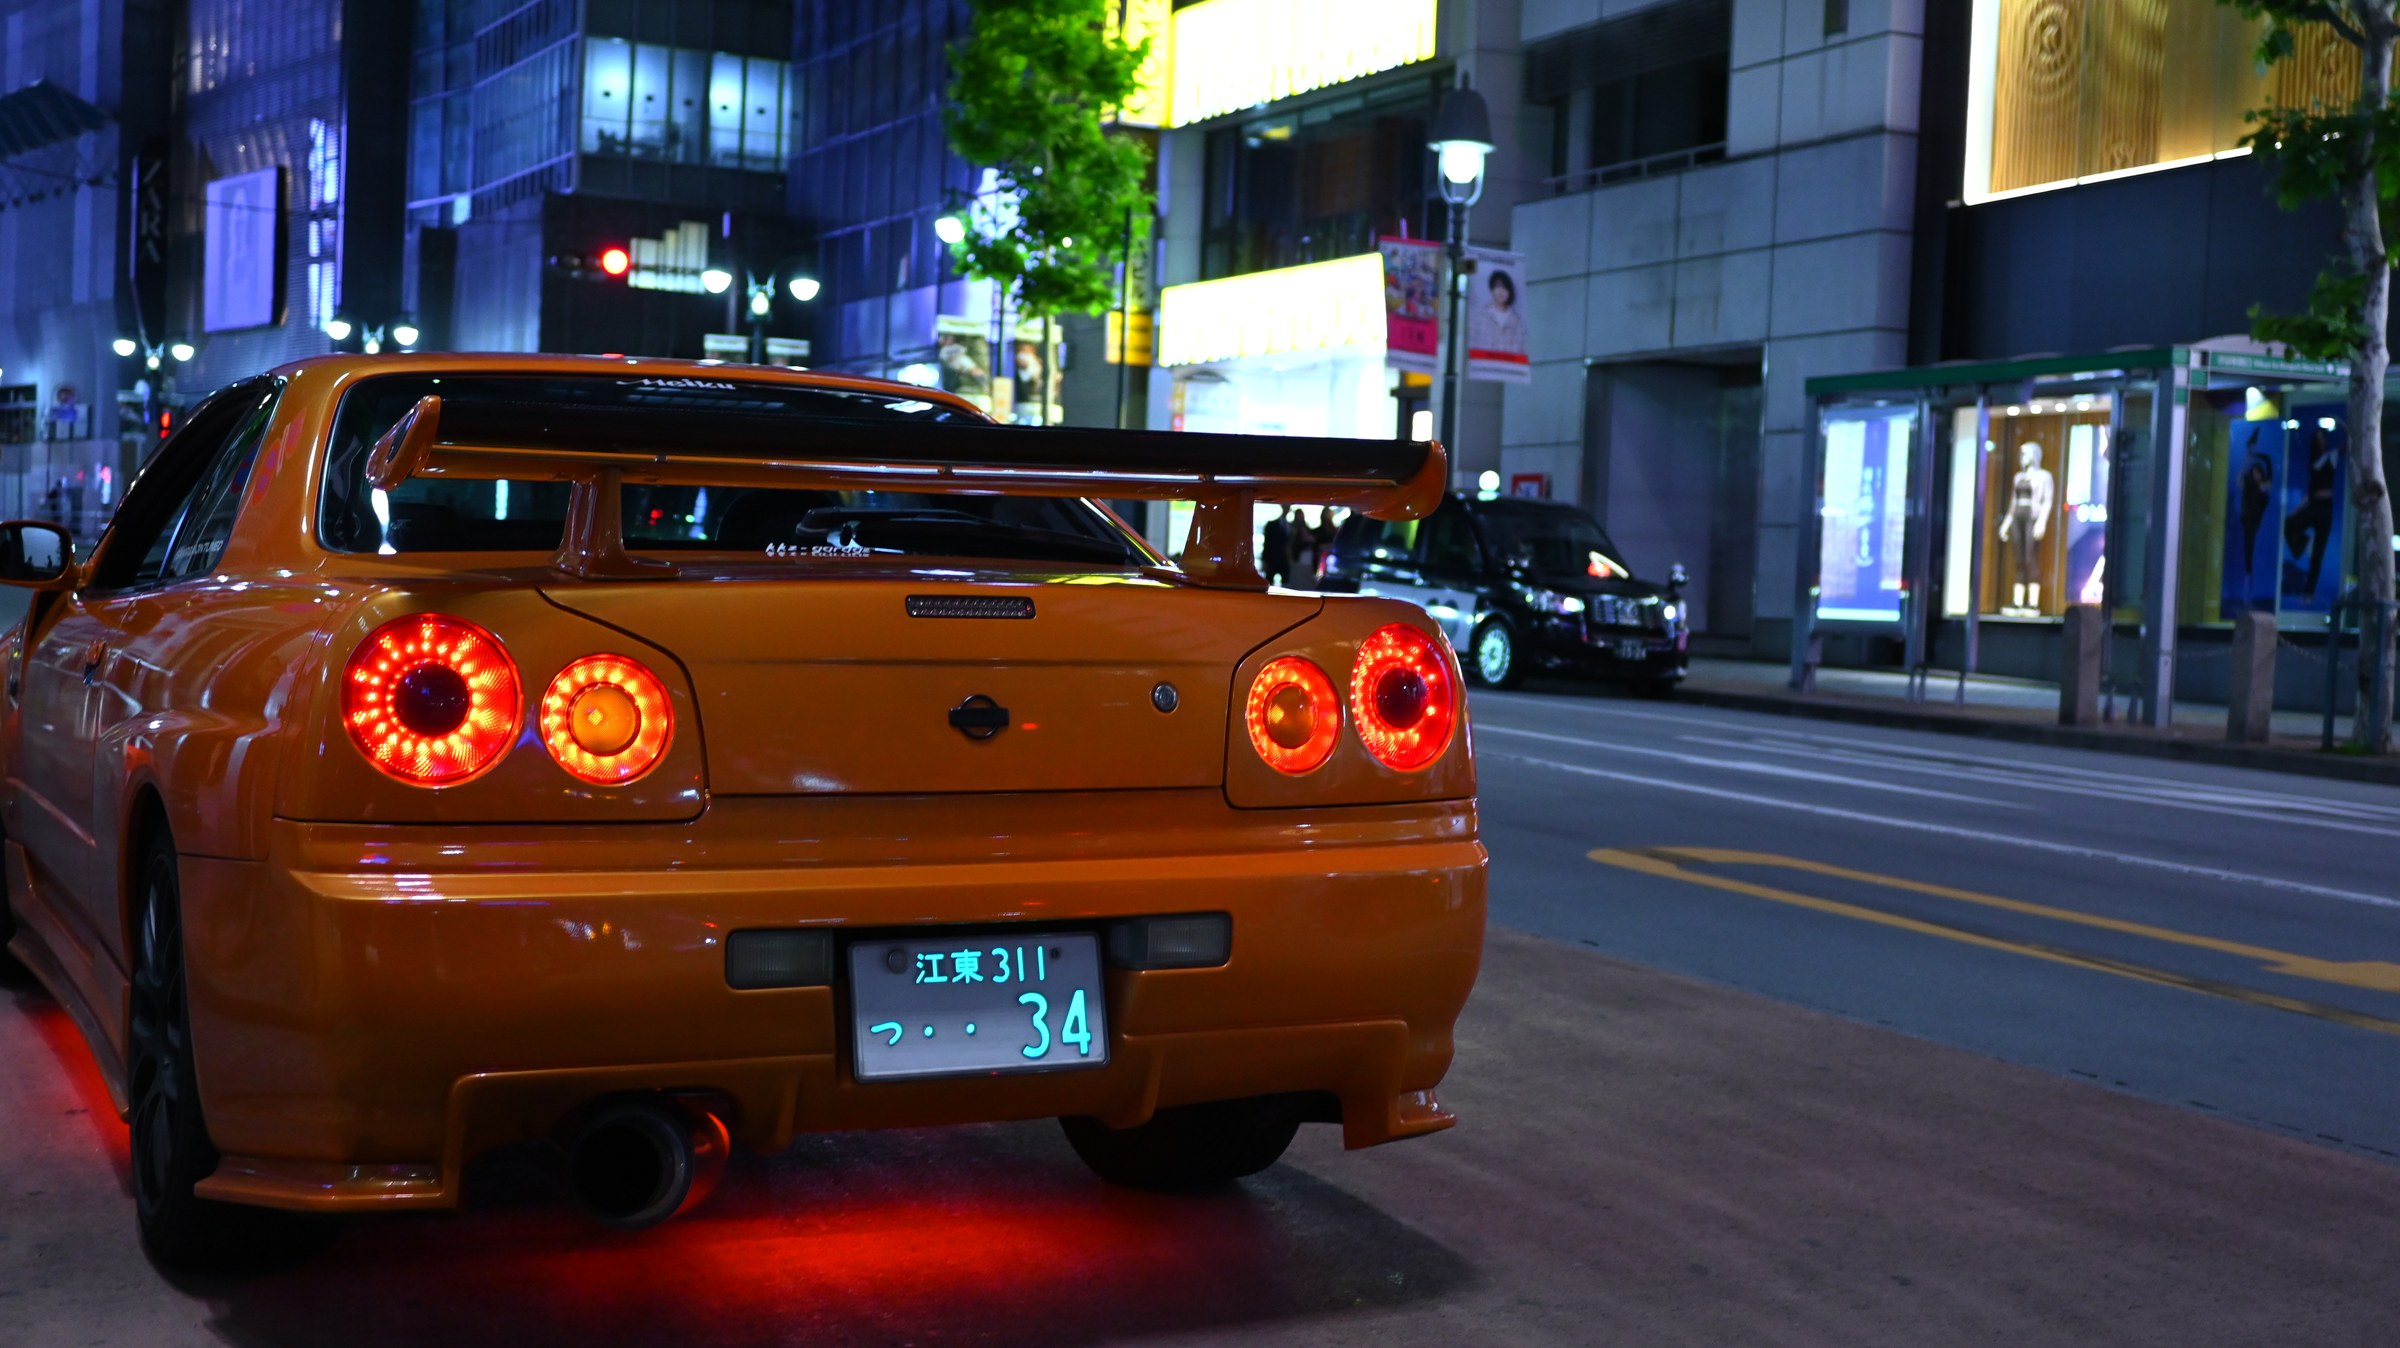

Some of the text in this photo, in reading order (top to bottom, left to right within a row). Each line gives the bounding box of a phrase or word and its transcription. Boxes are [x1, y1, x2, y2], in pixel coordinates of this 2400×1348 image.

[915, 945, 1046, 984] 江東 311
[1018, 989, 1092, 1059] 34
